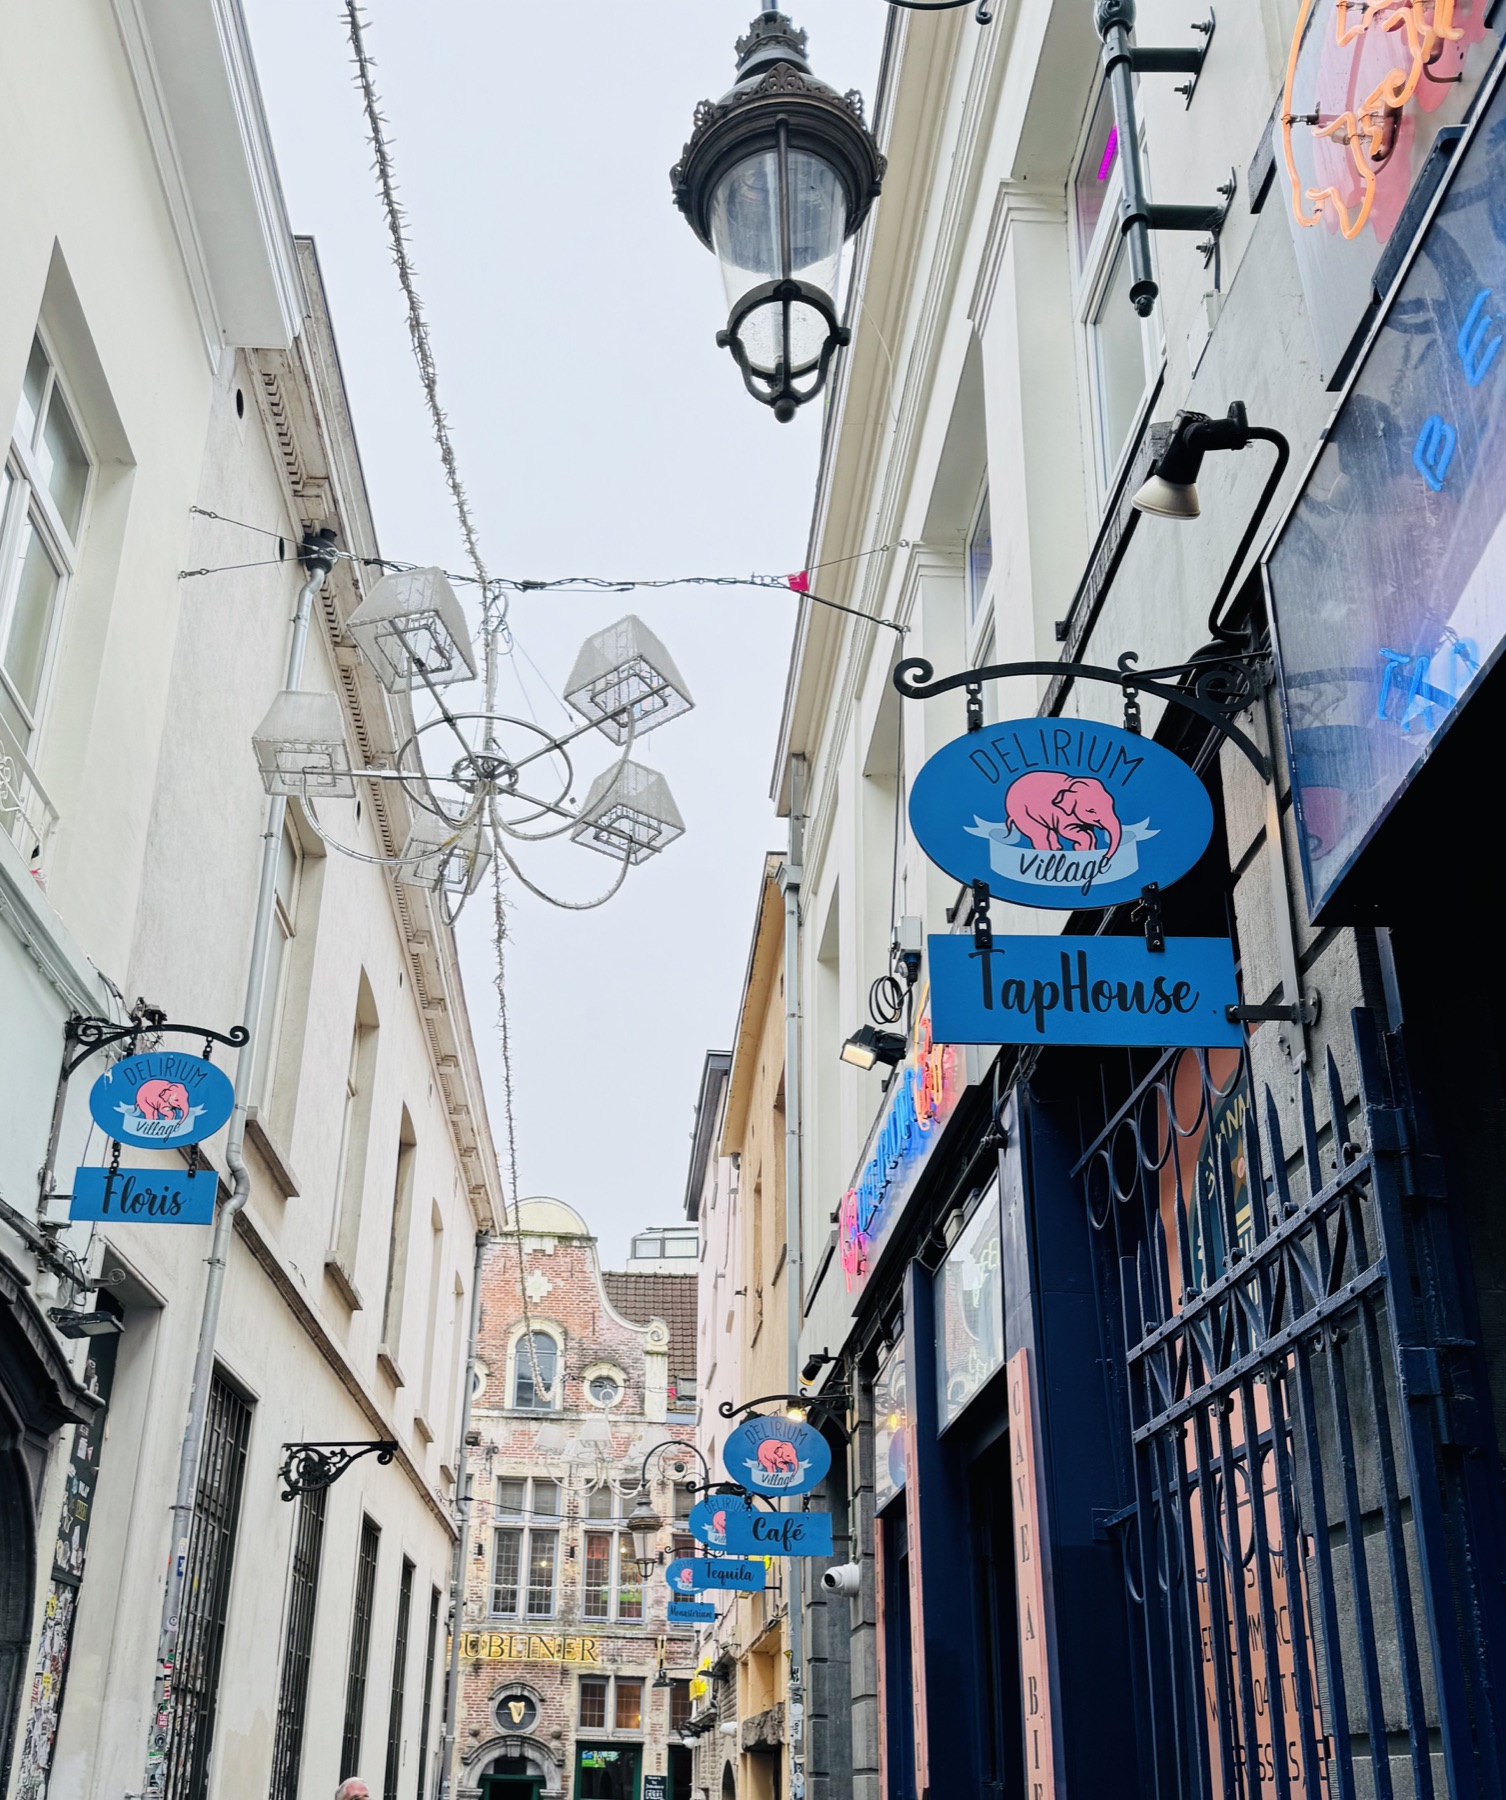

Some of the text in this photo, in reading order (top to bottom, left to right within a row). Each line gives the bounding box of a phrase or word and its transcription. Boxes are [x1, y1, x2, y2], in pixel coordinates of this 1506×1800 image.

[969, 728, 1144, 787] DELIRIUM
[1018, 852, 1112, 897] Village
[968, 948, 1200, 1035] TapHouse
[123, 1056, 208, 1088] DELIRIUM
[136, 1121, 181, 1142] Village
[102, 1173, 186, 1217] Floris
[744, 1419, 809, 1446] DELIRIUM
[761, 1473, 796, 1491] Village
[1013, 1381, 1030, 1563] CAVE
[752, 1516, 806, 1552] Café
[704, 1561, 754, 1587] Tequila
[457, 1633, 598, 1662] UBLINER
